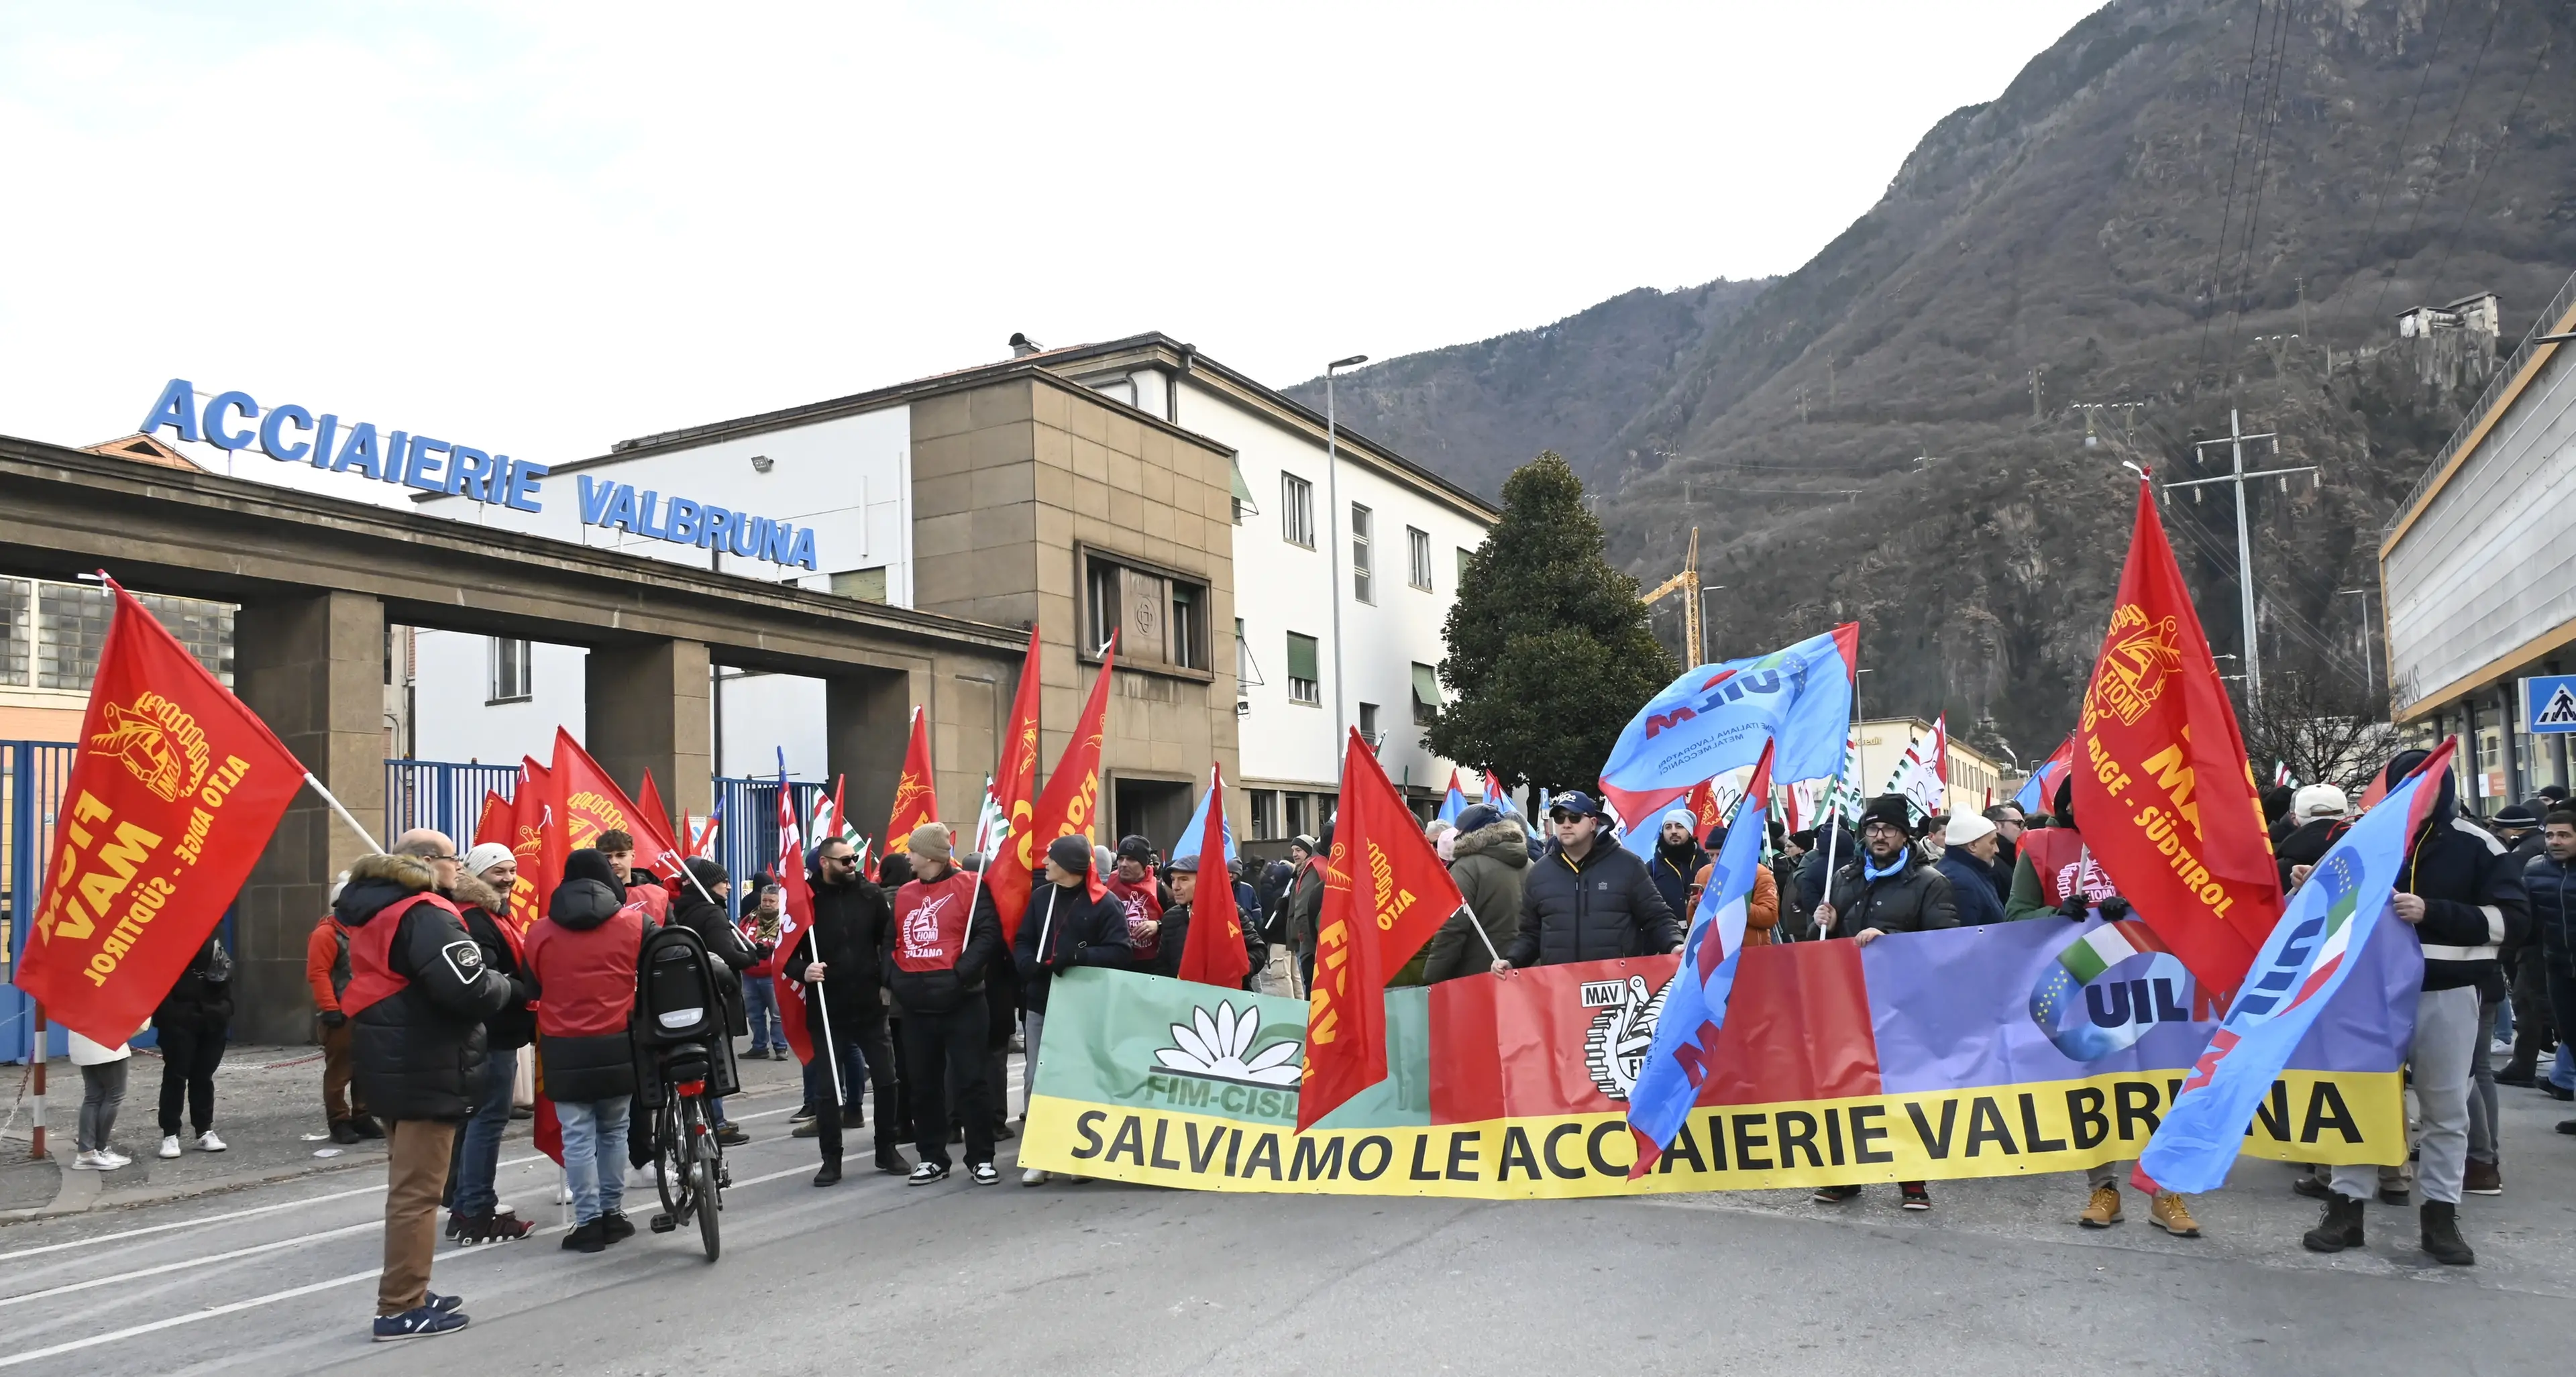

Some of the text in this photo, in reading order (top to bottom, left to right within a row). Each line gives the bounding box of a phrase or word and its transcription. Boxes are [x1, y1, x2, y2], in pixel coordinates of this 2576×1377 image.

[140, 378, 818, 571] ACCIAIERIE VALBRUNA
[2100, 671, 2141, 722] FIOM
[2086, 732, 2132, 797] ADIGE
[2133, 806, 2233, 920] SÜDTIROL
[917, 930, 936, 940] FIOM
[1585, 985, 1619, 1005] MAV
[2181, 915, 2326, 1095] UILM
[1073, 1080, 2364, 1182] SALVIAMO LE ACCAIERIE VALBRNA
[1144, 1075, 1299, 1120] FIM-CISL
